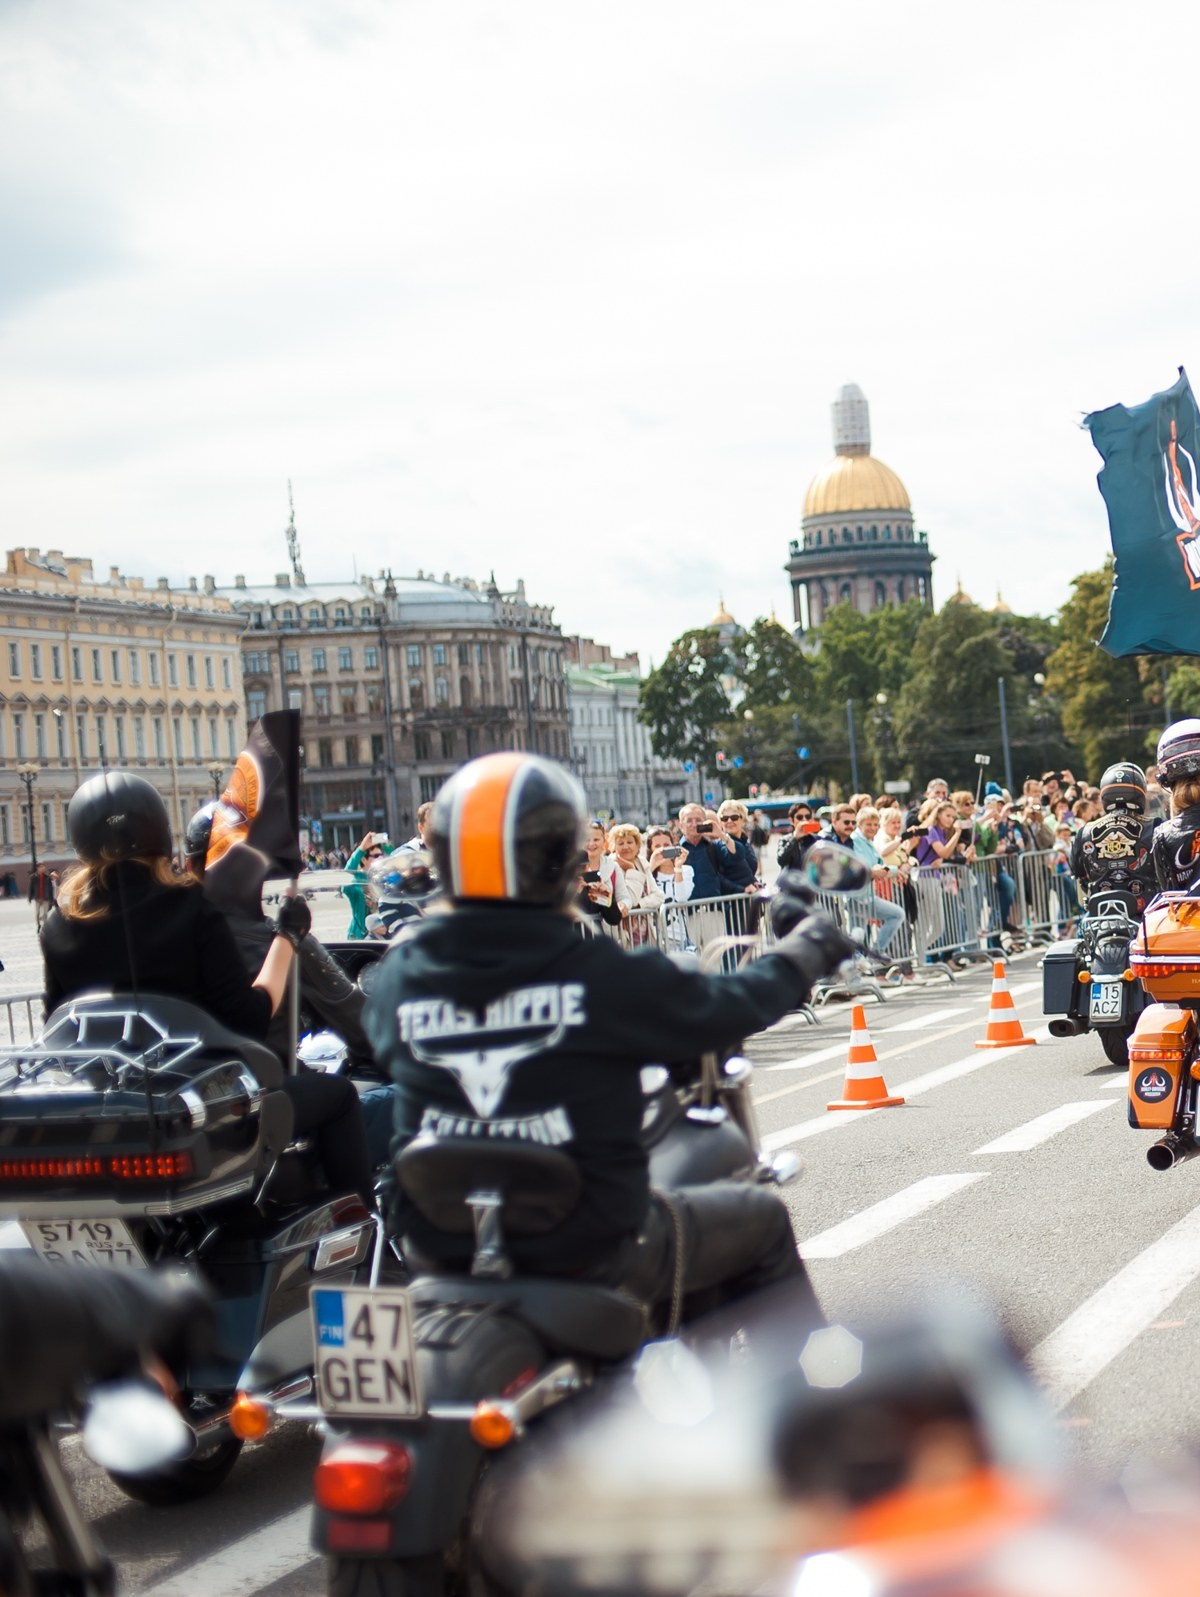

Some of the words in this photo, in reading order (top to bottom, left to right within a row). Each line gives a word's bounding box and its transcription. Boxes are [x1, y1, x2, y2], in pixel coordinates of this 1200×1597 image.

[1104, 986, 1119, 999] 15
[1093, 1001, 1118, 1014] ACZ
[37, 1222, 113, 1242] 5719
[85, 1241, 112, 1249] RUS
[320, 1326, 342, 1340] FIN
[351, 1304, 402, 1350] 47
[322, 1357, 412, 1404] GEN
